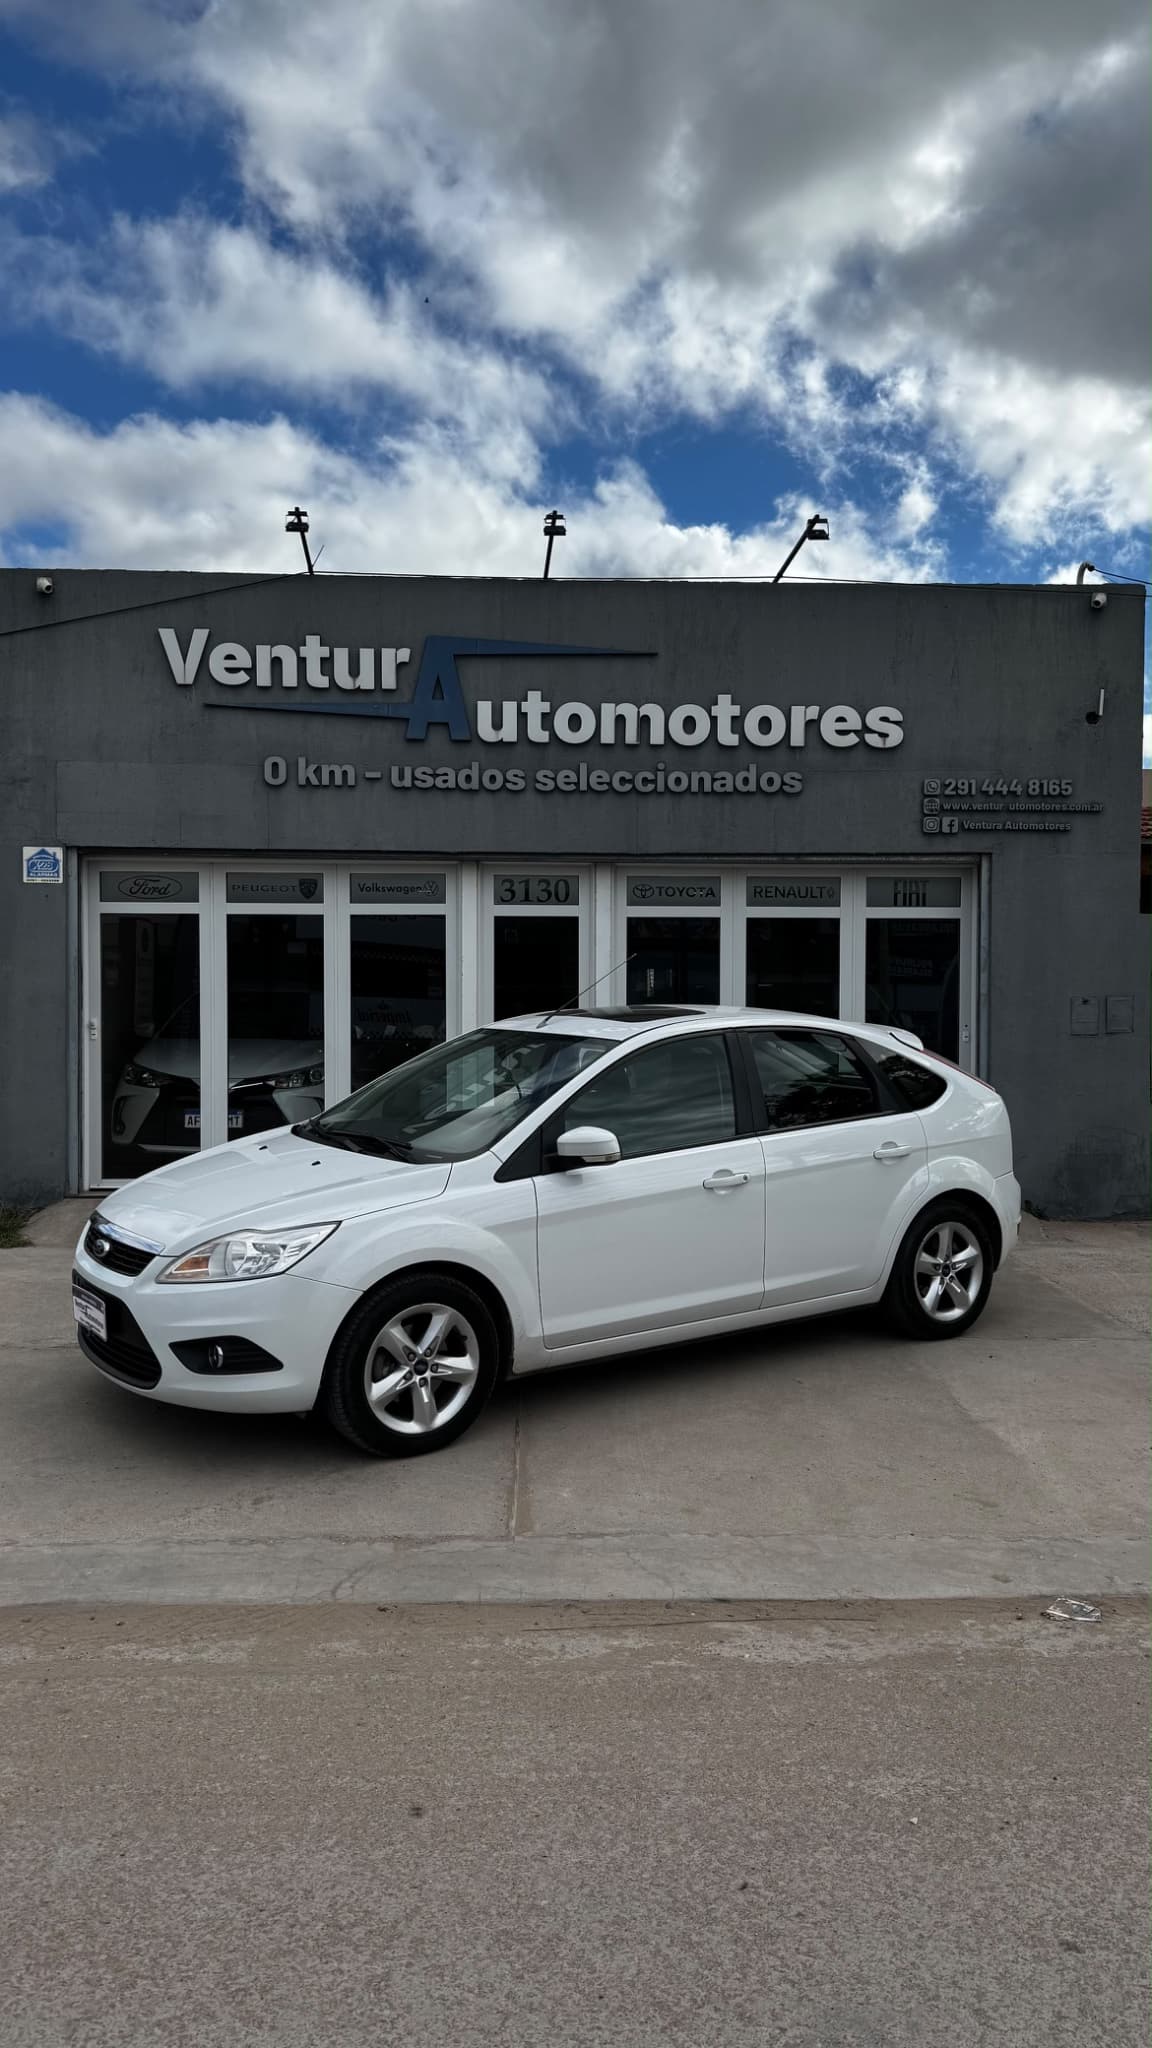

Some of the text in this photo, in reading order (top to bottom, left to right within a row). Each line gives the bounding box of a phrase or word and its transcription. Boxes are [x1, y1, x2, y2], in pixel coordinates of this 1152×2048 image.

[263, 756, 287, 786] 0
[298, 757, 357, 788] km
[390, 762, 526, 792] usados
[535, 763, 803, 794] seleccionados
[943, 778, 1073, 796] 291 444 8165
[962, 820, 1071, 832] Ventura Automotores
[128, 878, 170, 897] Ford
[232, 884, 297, 893] PEUGEOT
[358, 882, 423, 895] Volkswagen
[499, 878, 570, 903] 3130
[656, 886, 717, 898] TOYOTA
[753, 886, 826, 898] RENAULT
[893, 879, 929, 907] FIAT
